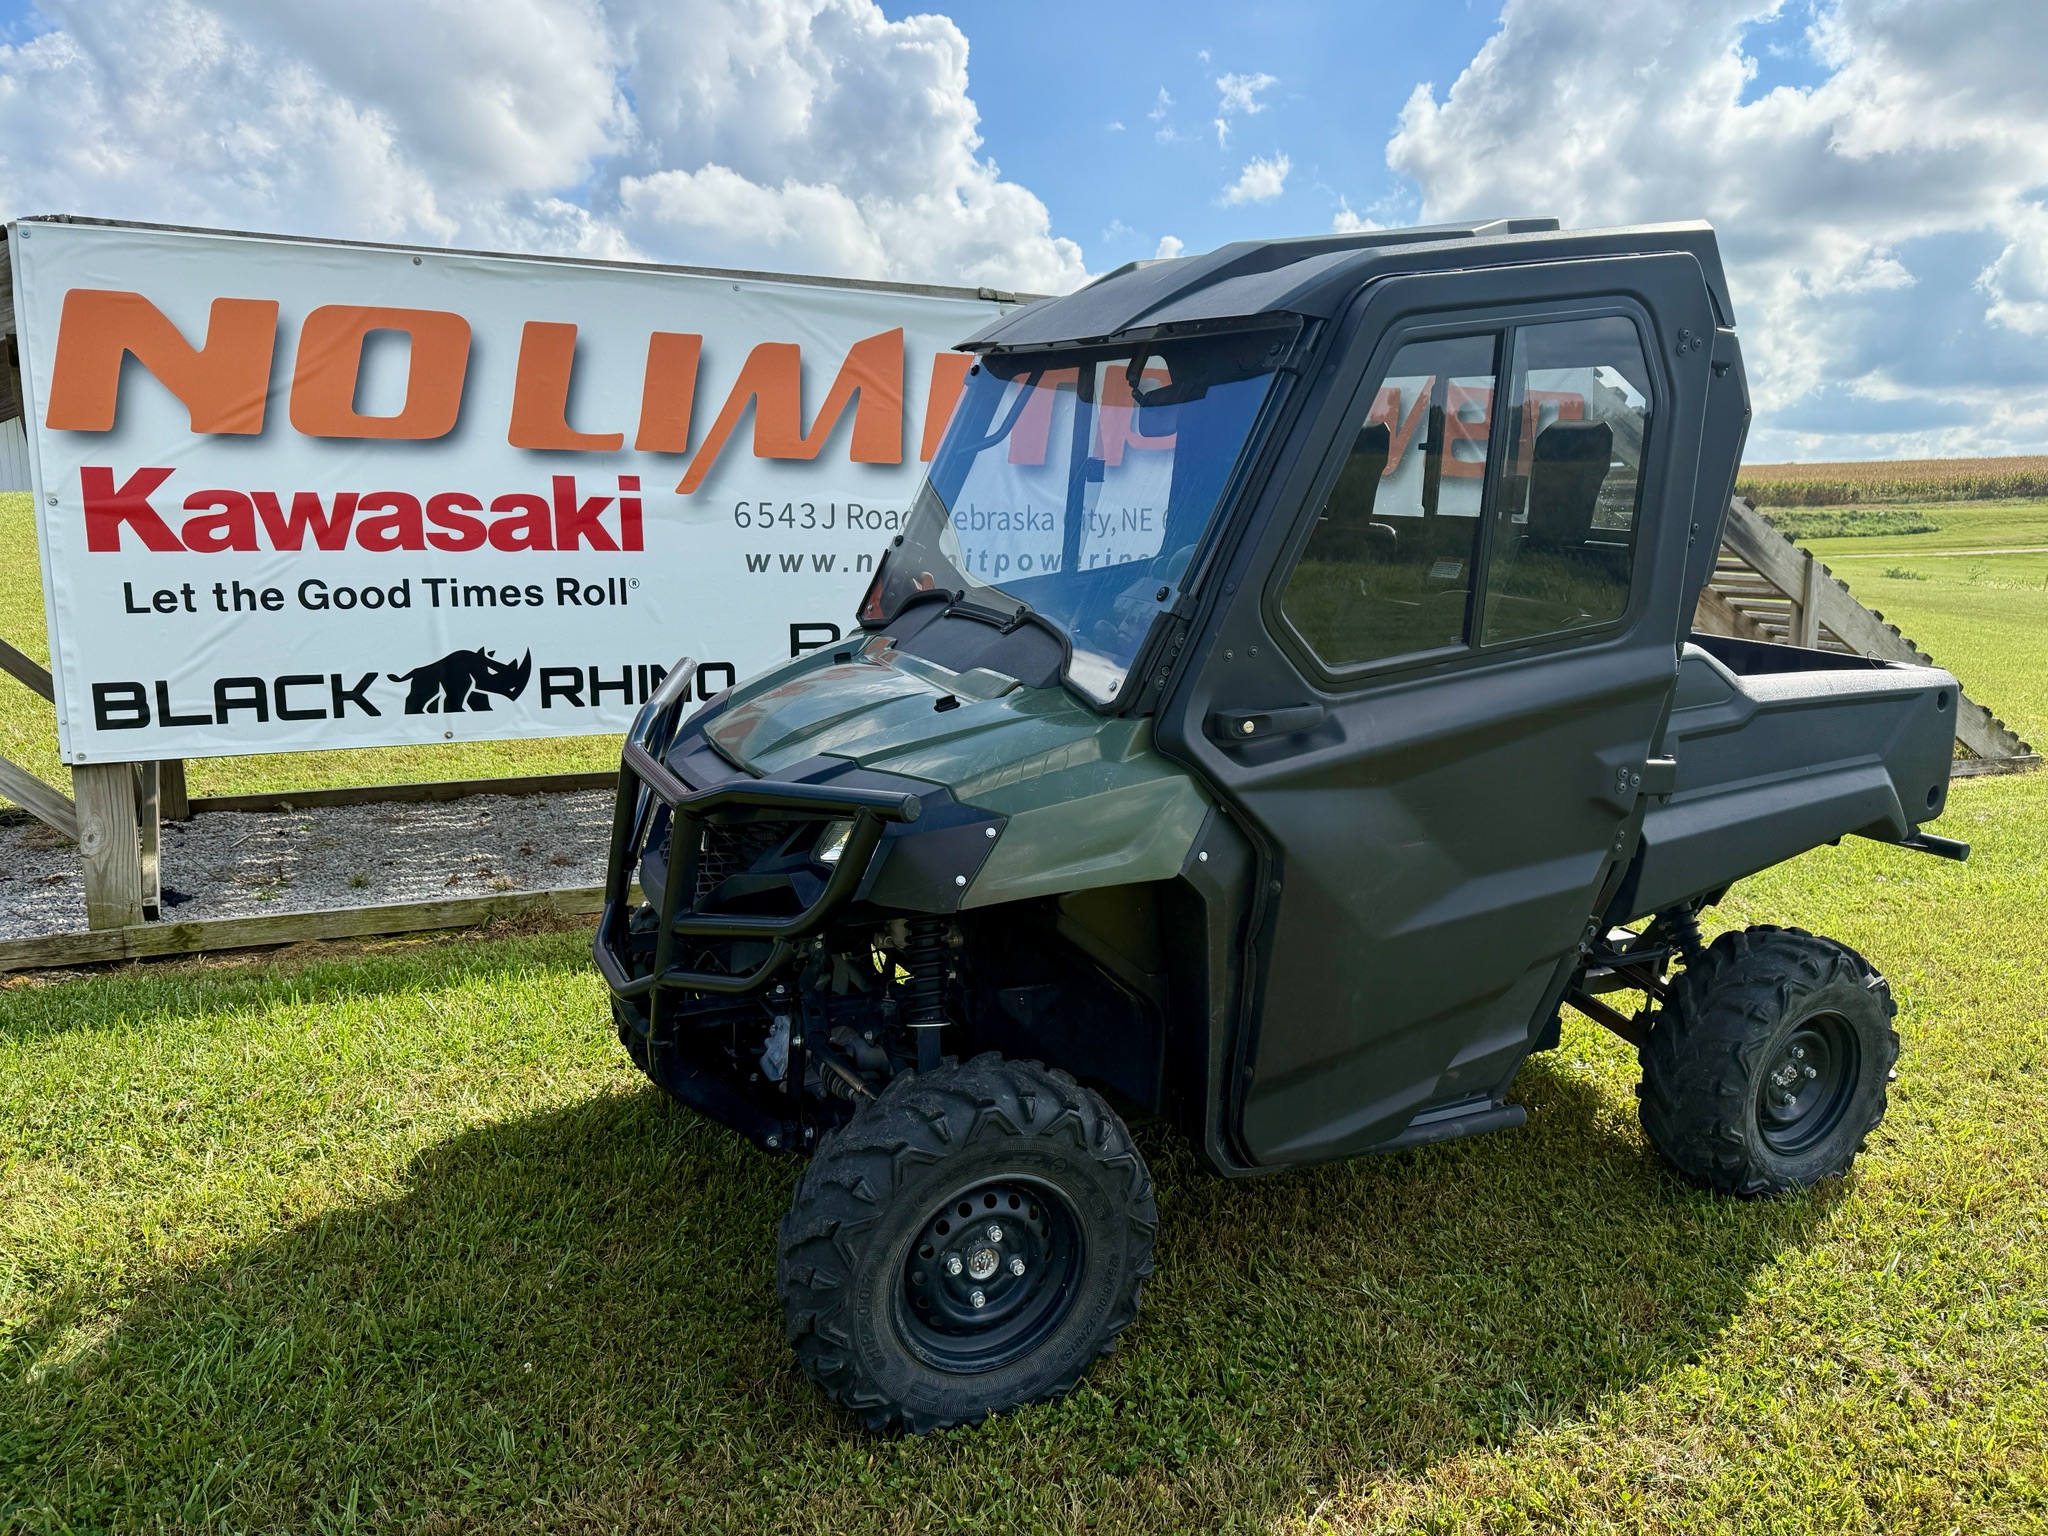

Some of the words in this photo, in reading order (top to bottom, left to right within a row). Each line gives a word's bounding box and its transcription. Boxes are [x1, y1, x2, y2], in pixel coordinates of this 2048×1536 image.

[45, 288, 472, 440] NO
[507, 320, 1080, 494] LIMIT
[80, 466, 645, 553] Kawasaki
[942, 503, 1054, 532] ebraska
[1064, 505, 1117, 538] ity,
[1122, 507, 1153, 532] NE
[123, 581, 197, 614] Let
[212, 580, 285, 612] the
[297, 578, 411, 610] Good
[421, 577, 544, 607] Times
[91, 672, 382, 731] BLACK
